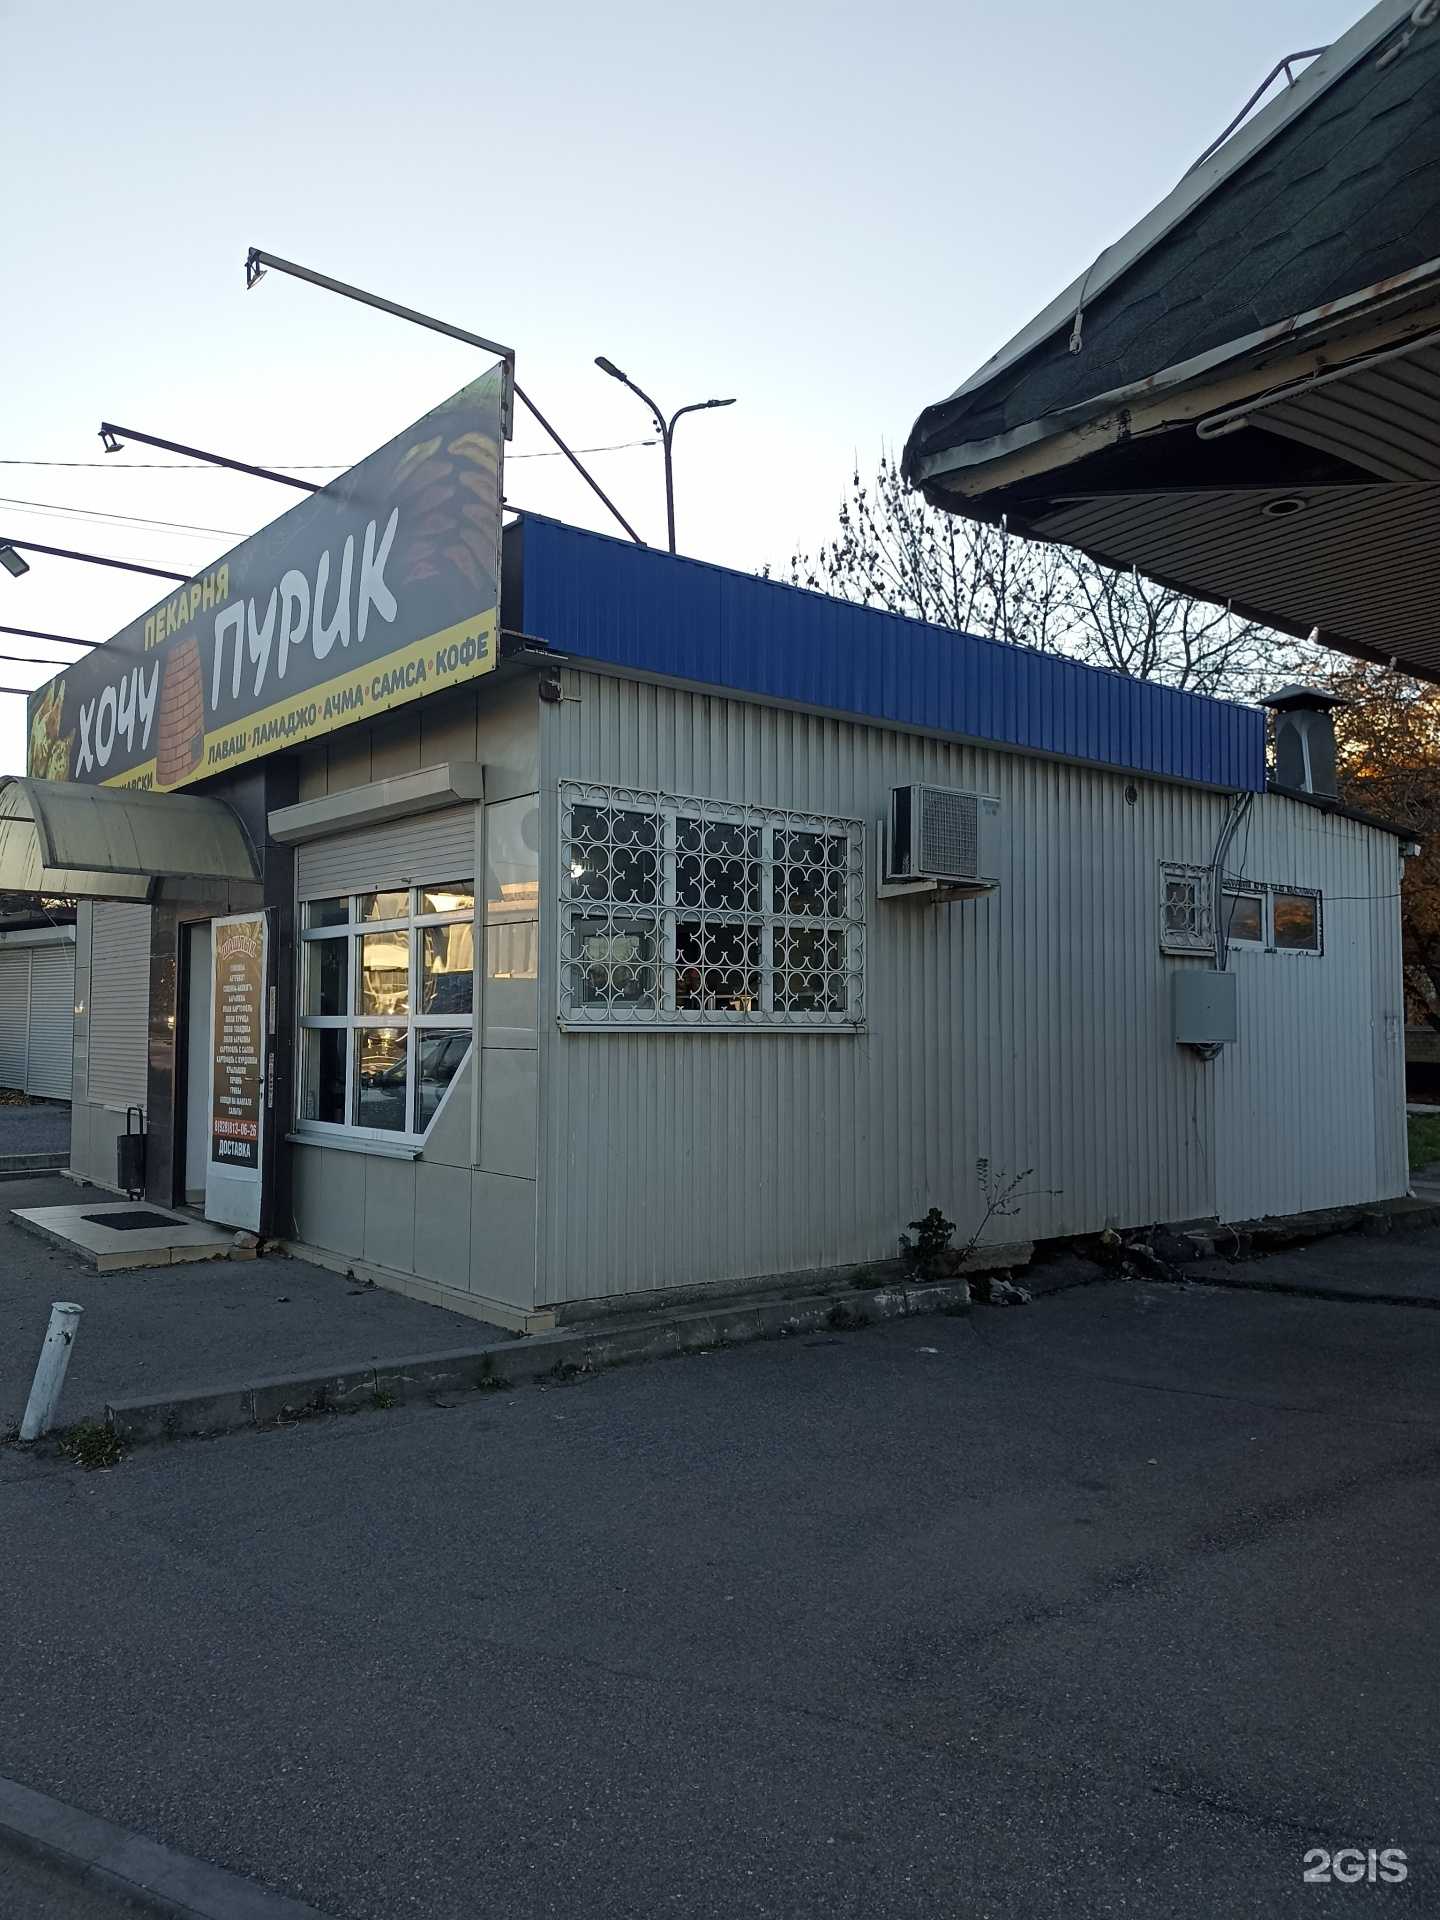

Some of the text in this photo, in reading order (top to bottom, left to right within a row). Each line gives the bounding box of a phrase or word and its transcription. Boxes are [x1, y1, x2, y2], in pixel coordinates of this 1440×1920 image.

[75, 507, 399, 778] ХОЧУ ПУРИК
[144, 563, 229, 652] ПЕКАРНЯ
[208, 631, 489, 765] ЛАВАШ ЛАМАДЖО АЧМА САМСА КОФЕ
[218, 1140, 251, 1158] ДОСТАВКА
